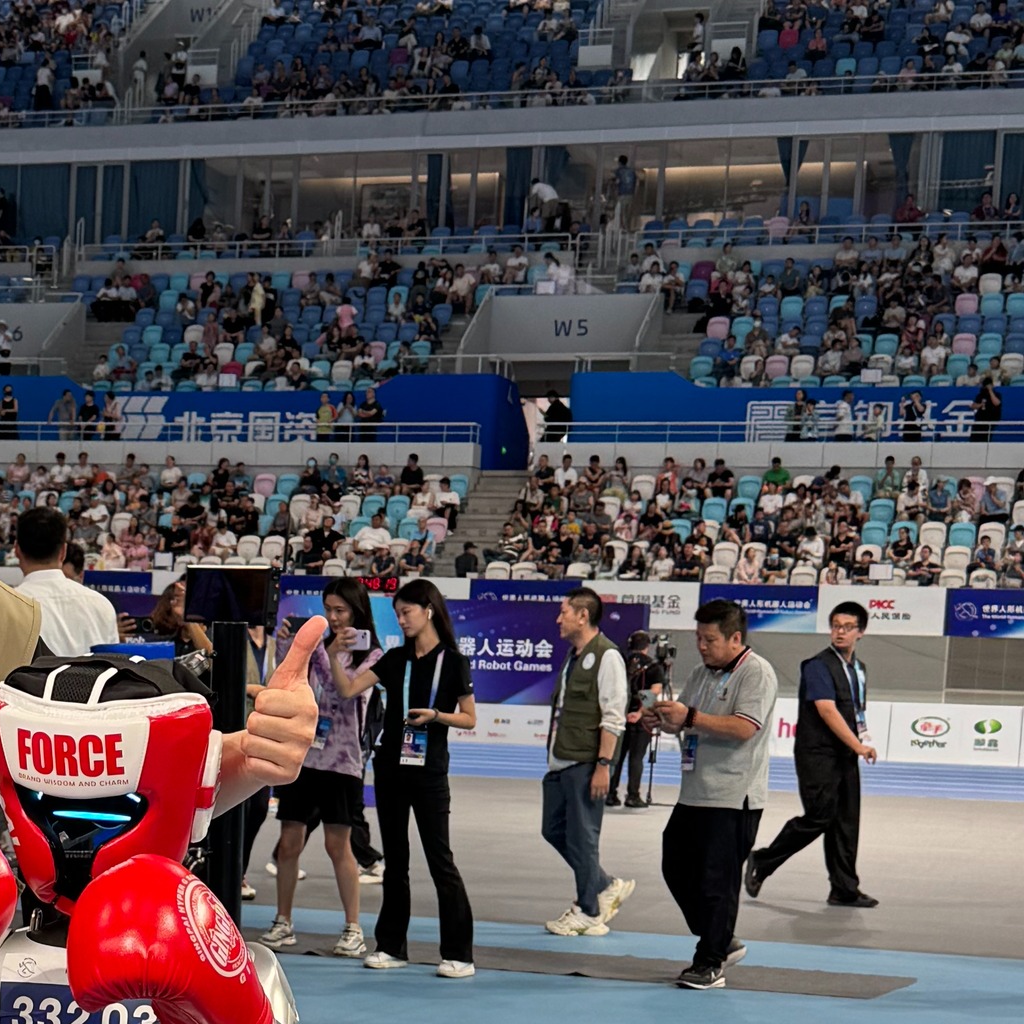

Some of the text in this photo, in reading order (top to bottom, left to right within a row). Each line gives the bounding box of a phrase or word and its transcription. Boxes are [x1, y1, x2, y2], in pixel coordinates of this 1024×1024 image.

[554, 319, 588, 337] W5
[174, 411, 318, 442] 北京国资
[868, 599, 895, 610] PICC
[982, 604, 1024, 613] 世界人形机
[478, 660, 511, 671] Robot
[513, 660, 553, 672] Games
[17, 728, 125, 777] FORCE
[18, 772, 41, 783] BRAND
[44, 779, 76, 787] WISDOM
[99, 779, 129, 787] CHARM
[176, 884, 185, 914] HYPER
[181, 916, 206, 962] GINGPAI
